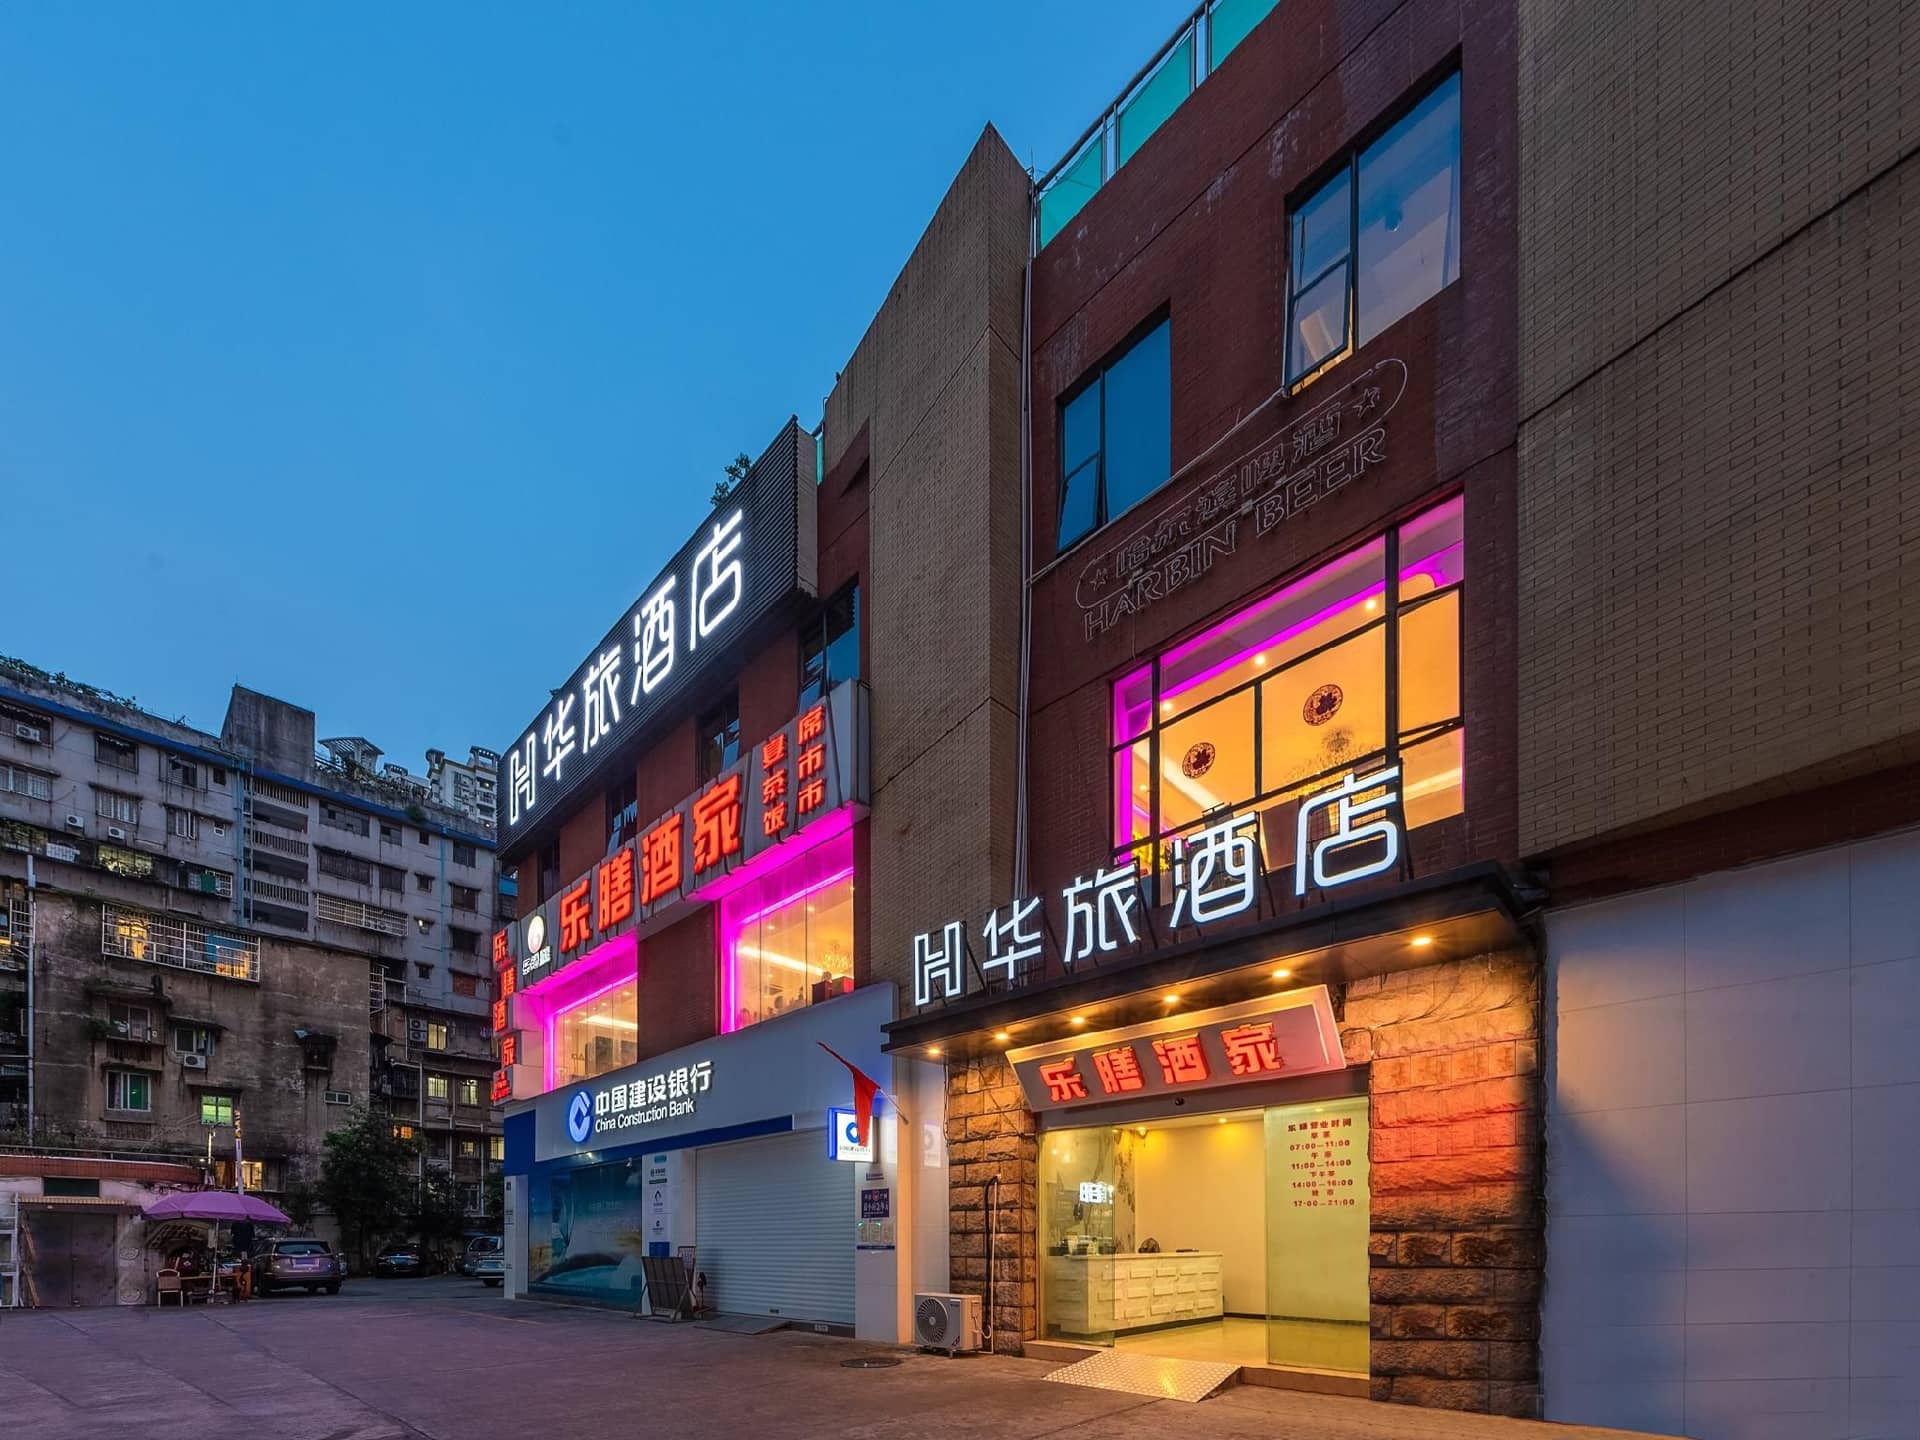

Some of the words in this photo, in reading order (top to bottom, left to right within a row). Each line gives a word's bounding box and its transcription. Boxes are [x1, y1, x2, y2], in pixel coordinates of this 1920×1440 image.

[1084, 520, 1236, 641] HARBIN
[1256, 428, 1387, 537] BEER
[560, 773, 741, 954] 乐膳酒家
[595, 1061, 712, 1115] 中国建设银行
[1039, 1021, 1281, 1102] 乐膳酒家
[595, 1115, 616, 1133] China
[617, 1104, 668, 1126] Construction
[669, 1098, 695, 1116] Bank
